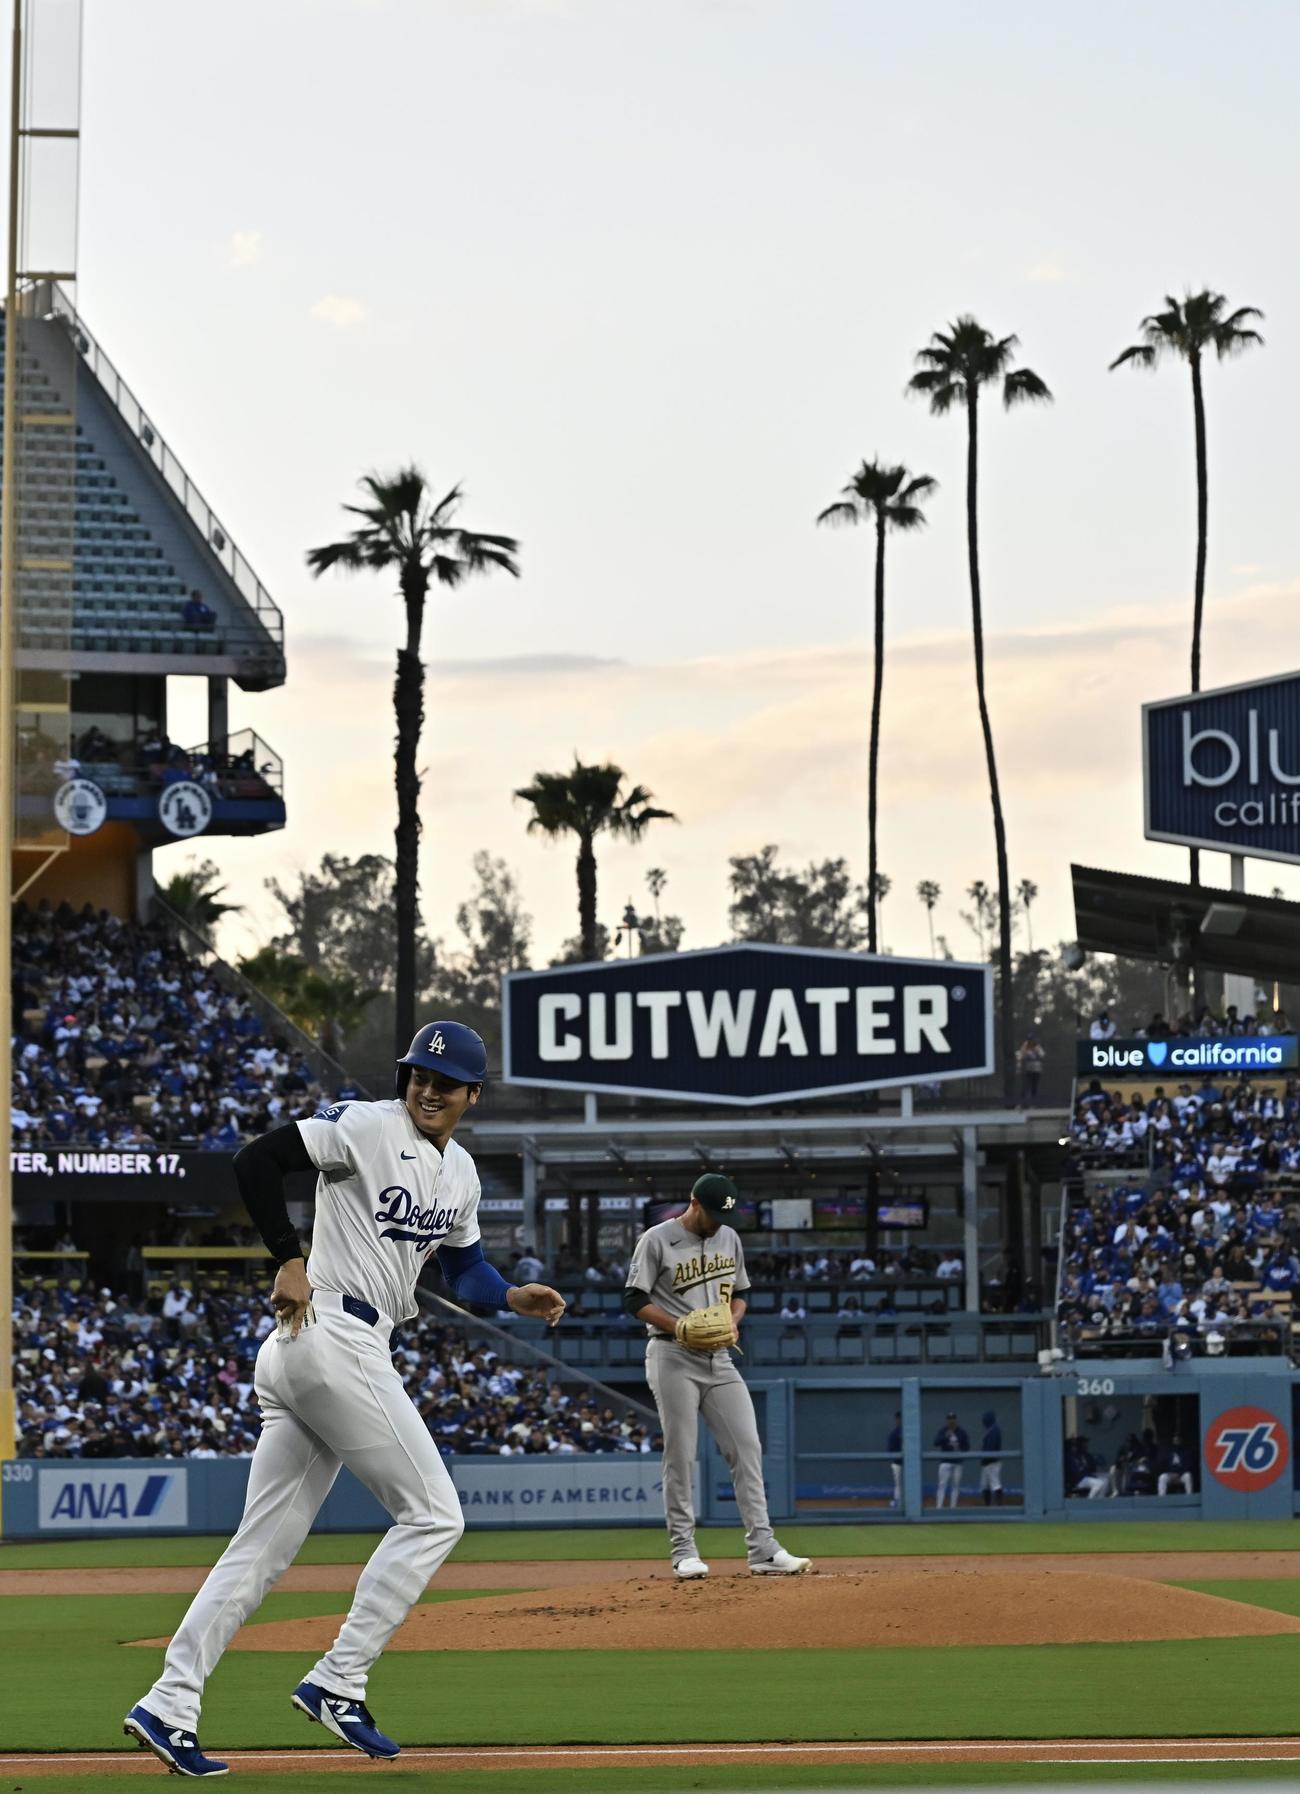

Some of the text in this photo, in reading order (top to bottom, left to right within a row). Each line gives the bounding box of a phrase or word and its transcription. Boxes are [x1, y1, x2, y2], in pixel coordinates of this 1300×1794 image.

[537, 984, 951, 1062] CUTWATER
[427, 1030, 446, 1055] LA
[1092, 1042, 1283, 1067] blue california
[57, 1153, 152, 1174] NUMBER
[156, 1154, 186, 1178] 17,
[719, 1282, 733, 1304] 5
[1077, 1378, 1114, 1396] 360
[1215, 1422, 1279, 1473] 76
[2, 1464, 33, 1483] 330
[50, 1483, 129, 1520] ANA
[458, 1486, 647, 1505] BANK OF AMERICA
